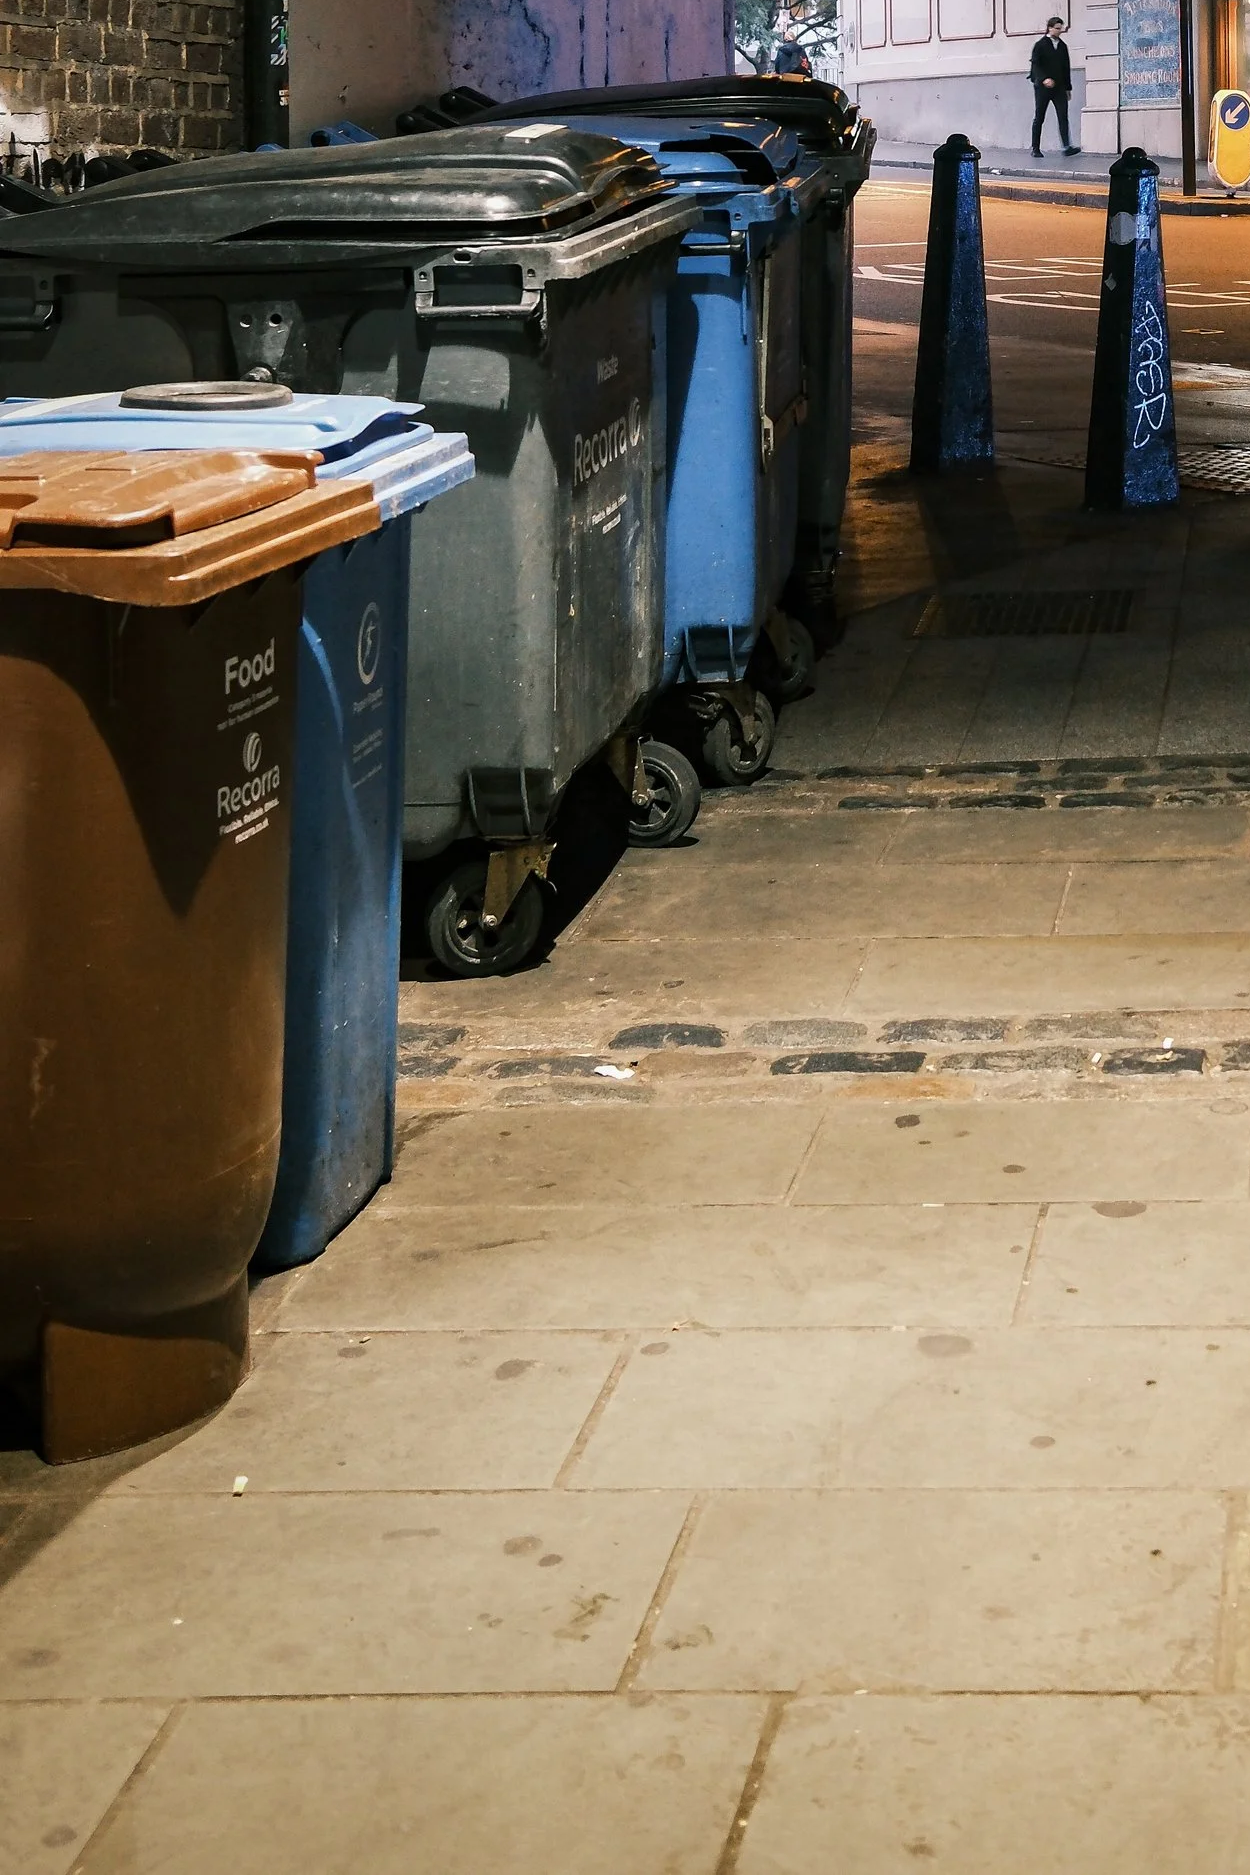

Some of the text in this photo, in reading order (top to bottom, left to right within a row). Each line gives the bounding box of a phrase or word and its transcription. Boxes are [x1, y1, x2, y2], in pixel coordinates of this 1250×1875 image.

[573, 415, 628, 487] Recorra
[225, 637, 276, 695] Food
[217, 764, 281, 818] Recorra
